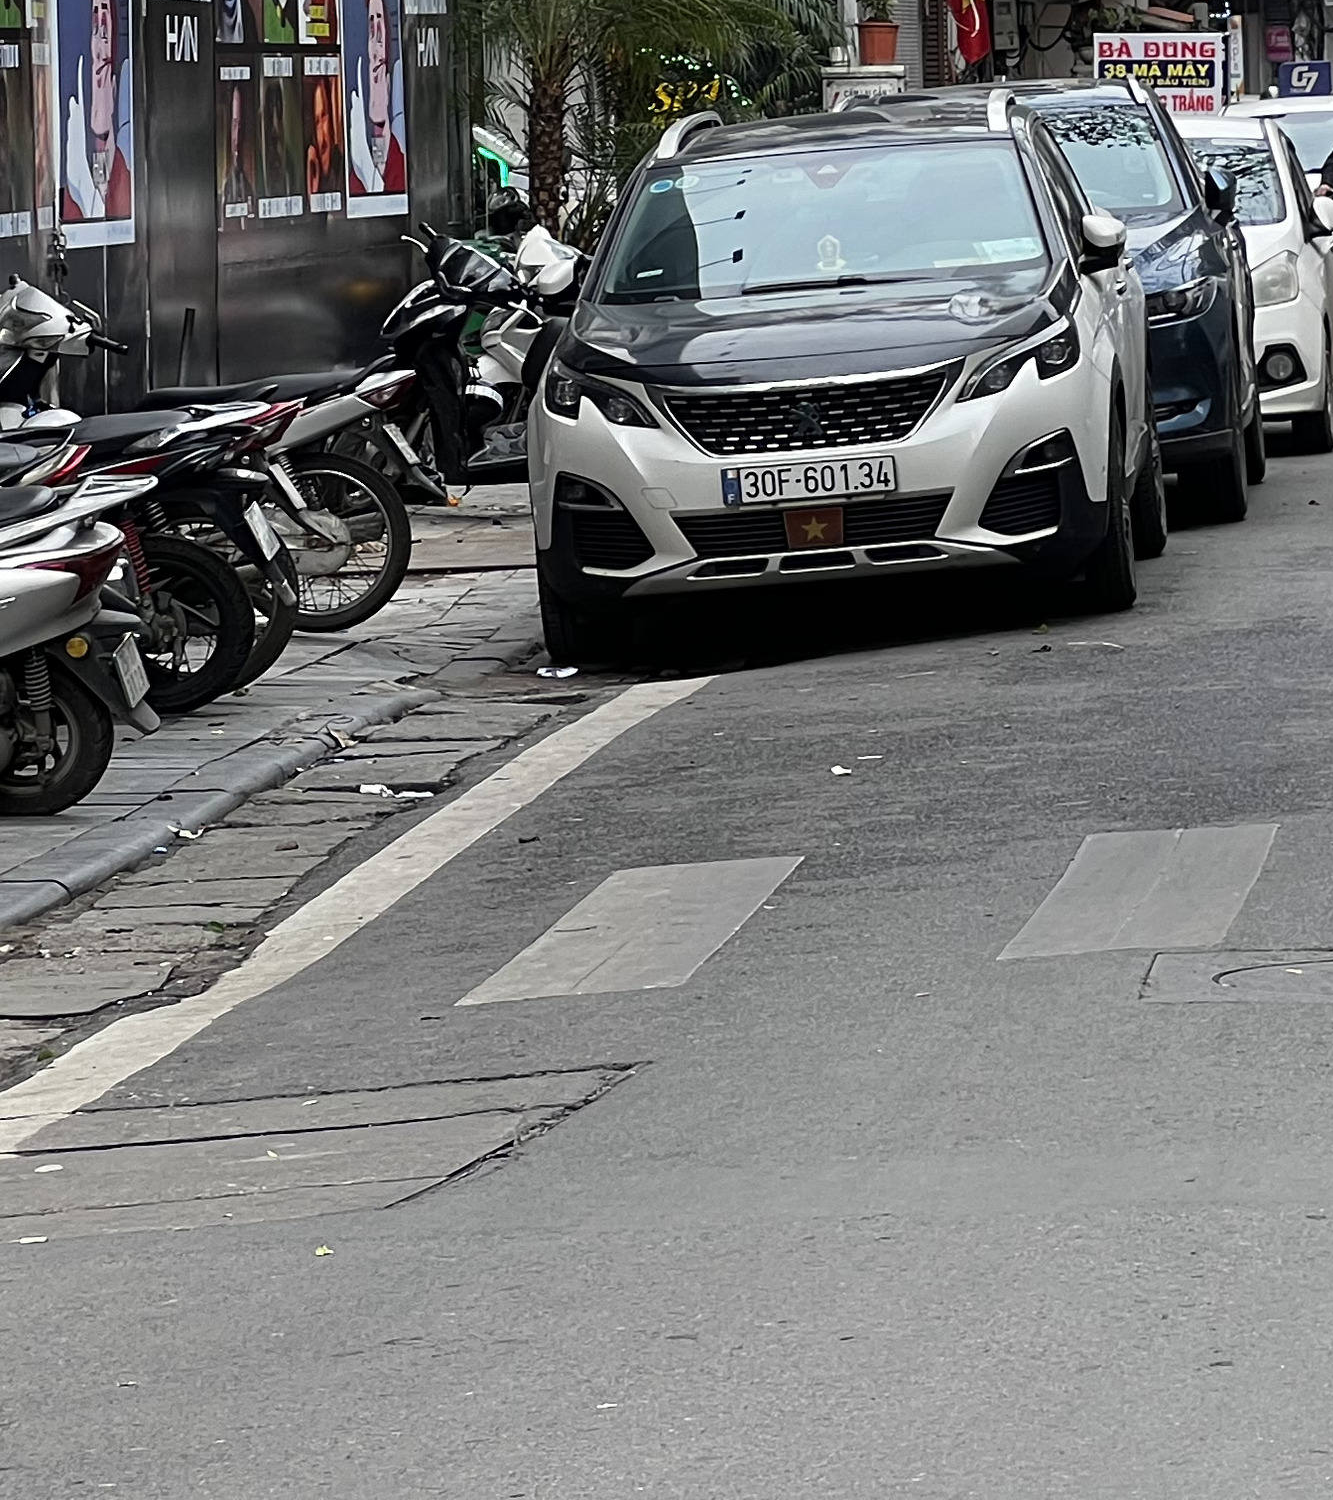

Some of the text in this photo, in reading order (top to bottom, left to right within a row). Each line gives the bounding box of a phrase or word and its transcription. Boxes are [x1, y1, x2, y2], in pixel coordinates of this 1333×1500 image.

[1103, 63, 1128, 79] 38
[1290, 65, 1319, 93] G7
[743, 460, 891, 499] 30F-601.34
